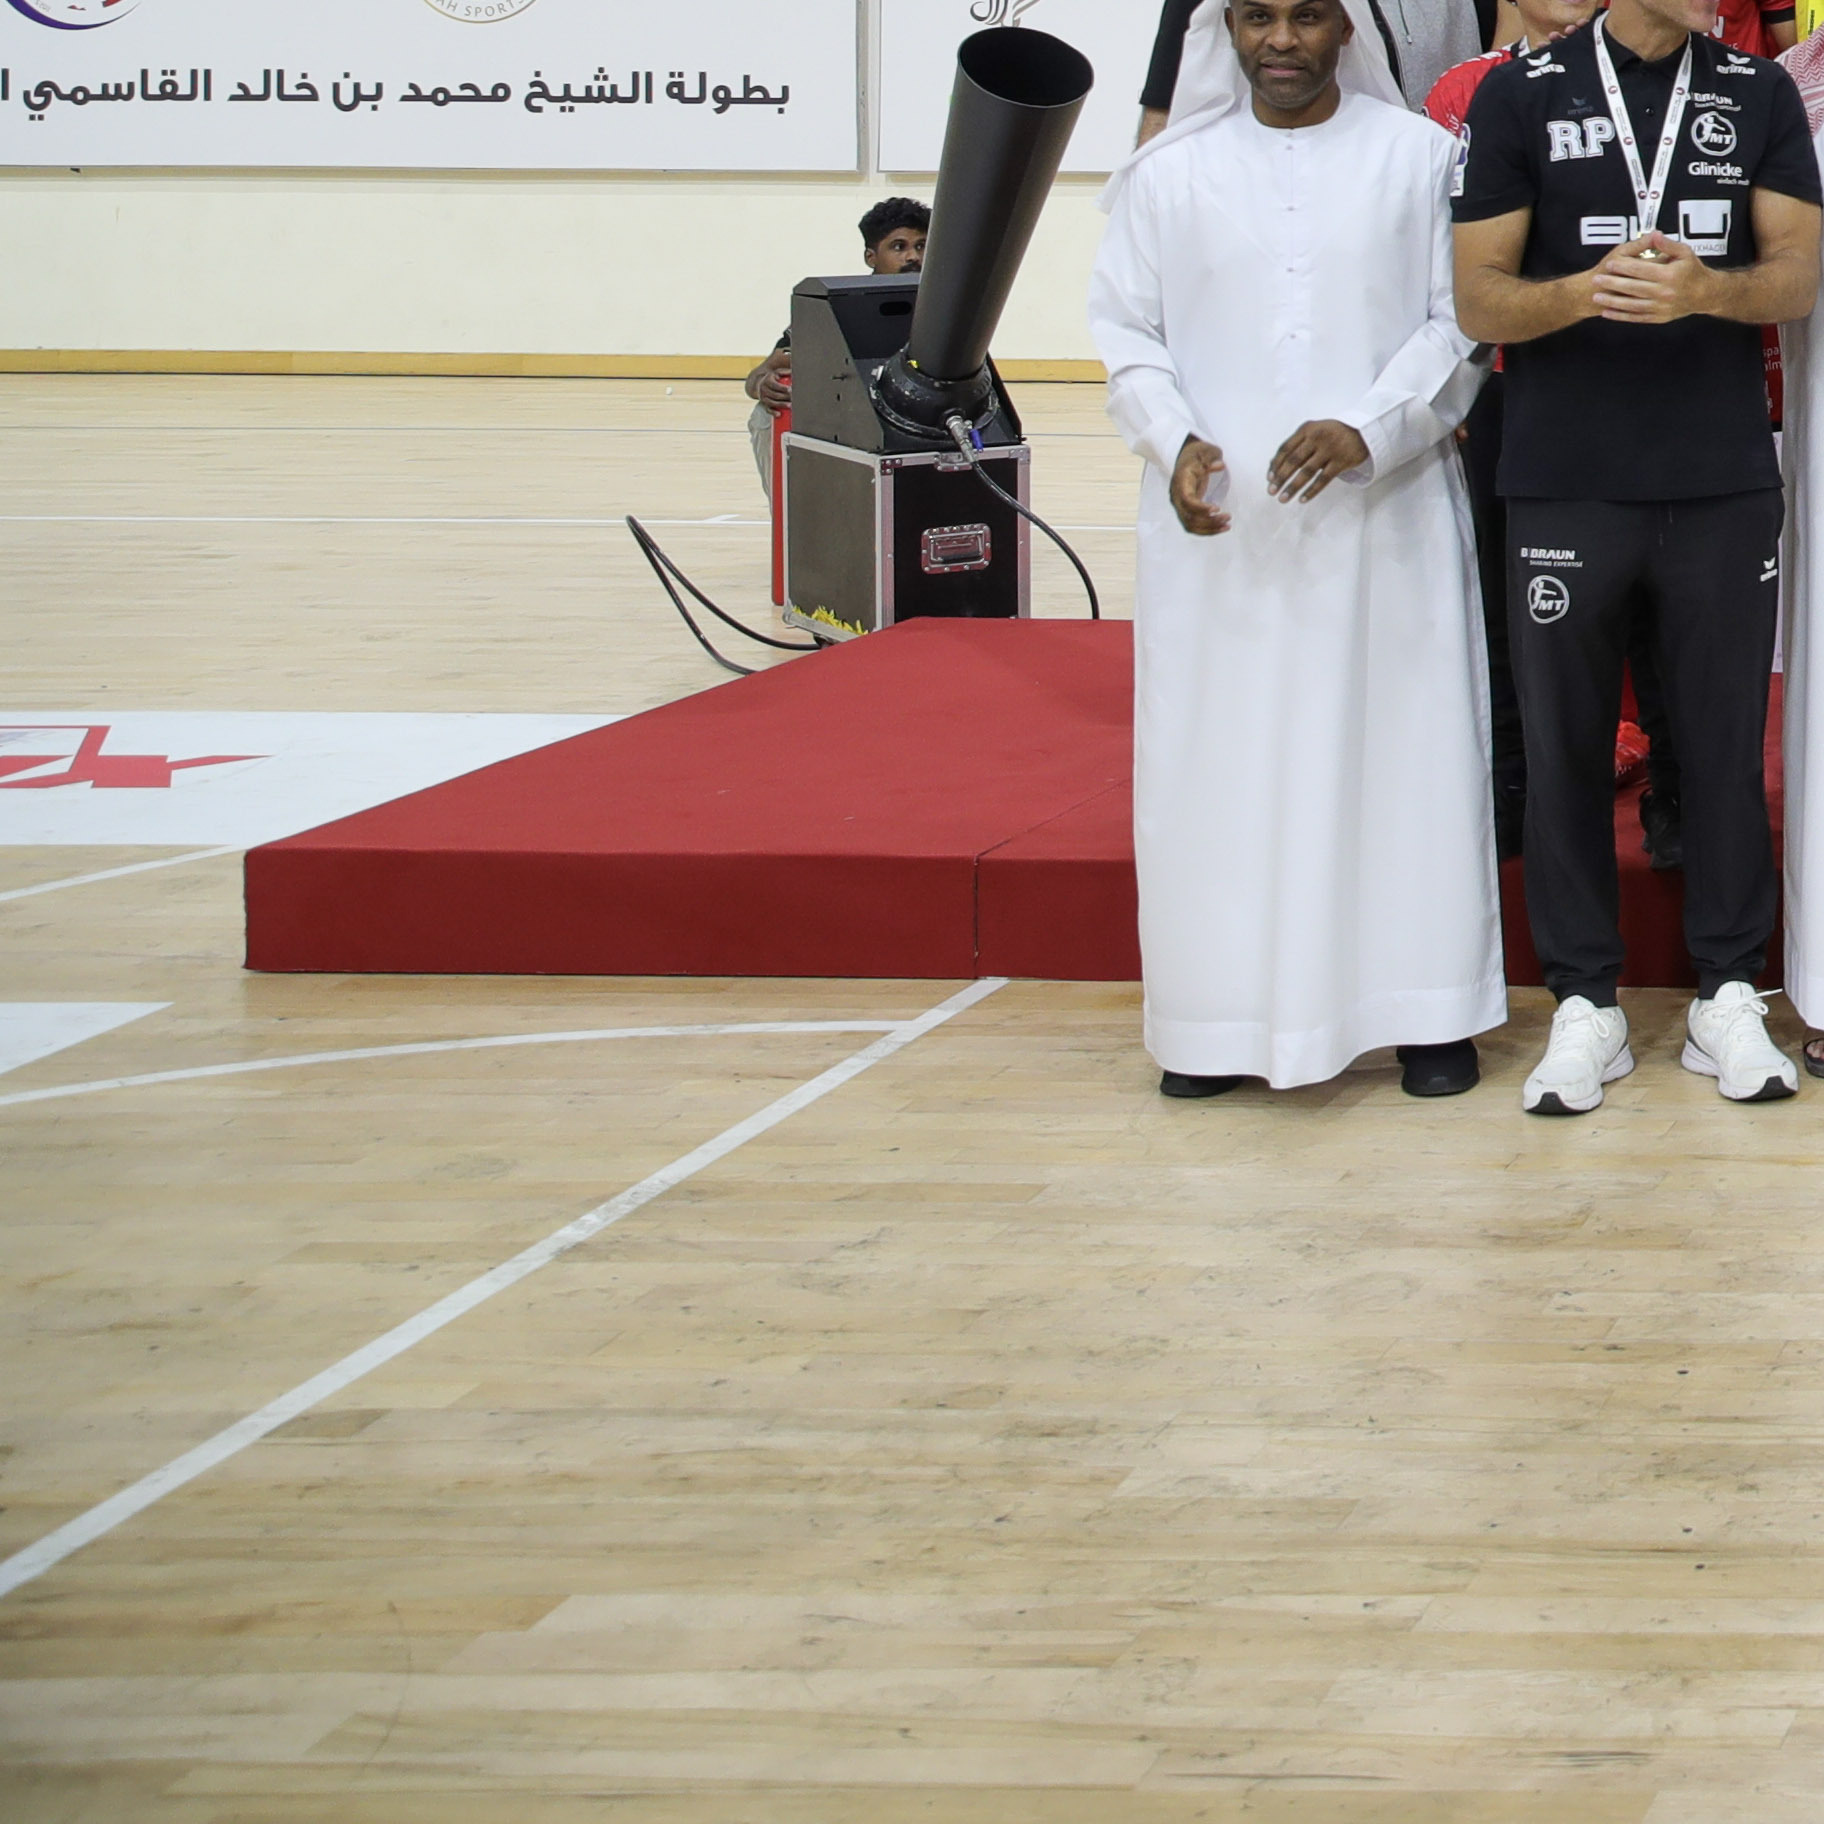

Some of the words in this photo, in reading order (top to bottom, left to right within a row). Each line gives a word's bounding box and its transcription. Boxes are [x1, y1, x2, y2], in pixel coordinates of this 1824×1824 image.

[22, 68, 212, 121] القاسمي
[226, 70, 318, 105] خالد
[331, 71, 385, 112] بن
[398, 77, 512, 105] محمد
[523, 66, 654, 116] الشيخ
[664, 68, 790, 115] بطولة
[1546, 116, 1616, 162] RP
[1708, 132, 1734, 145] MT
[1688, 161, 1743, 177] Glinicke
[1538, 598, 1566, 612] MT
